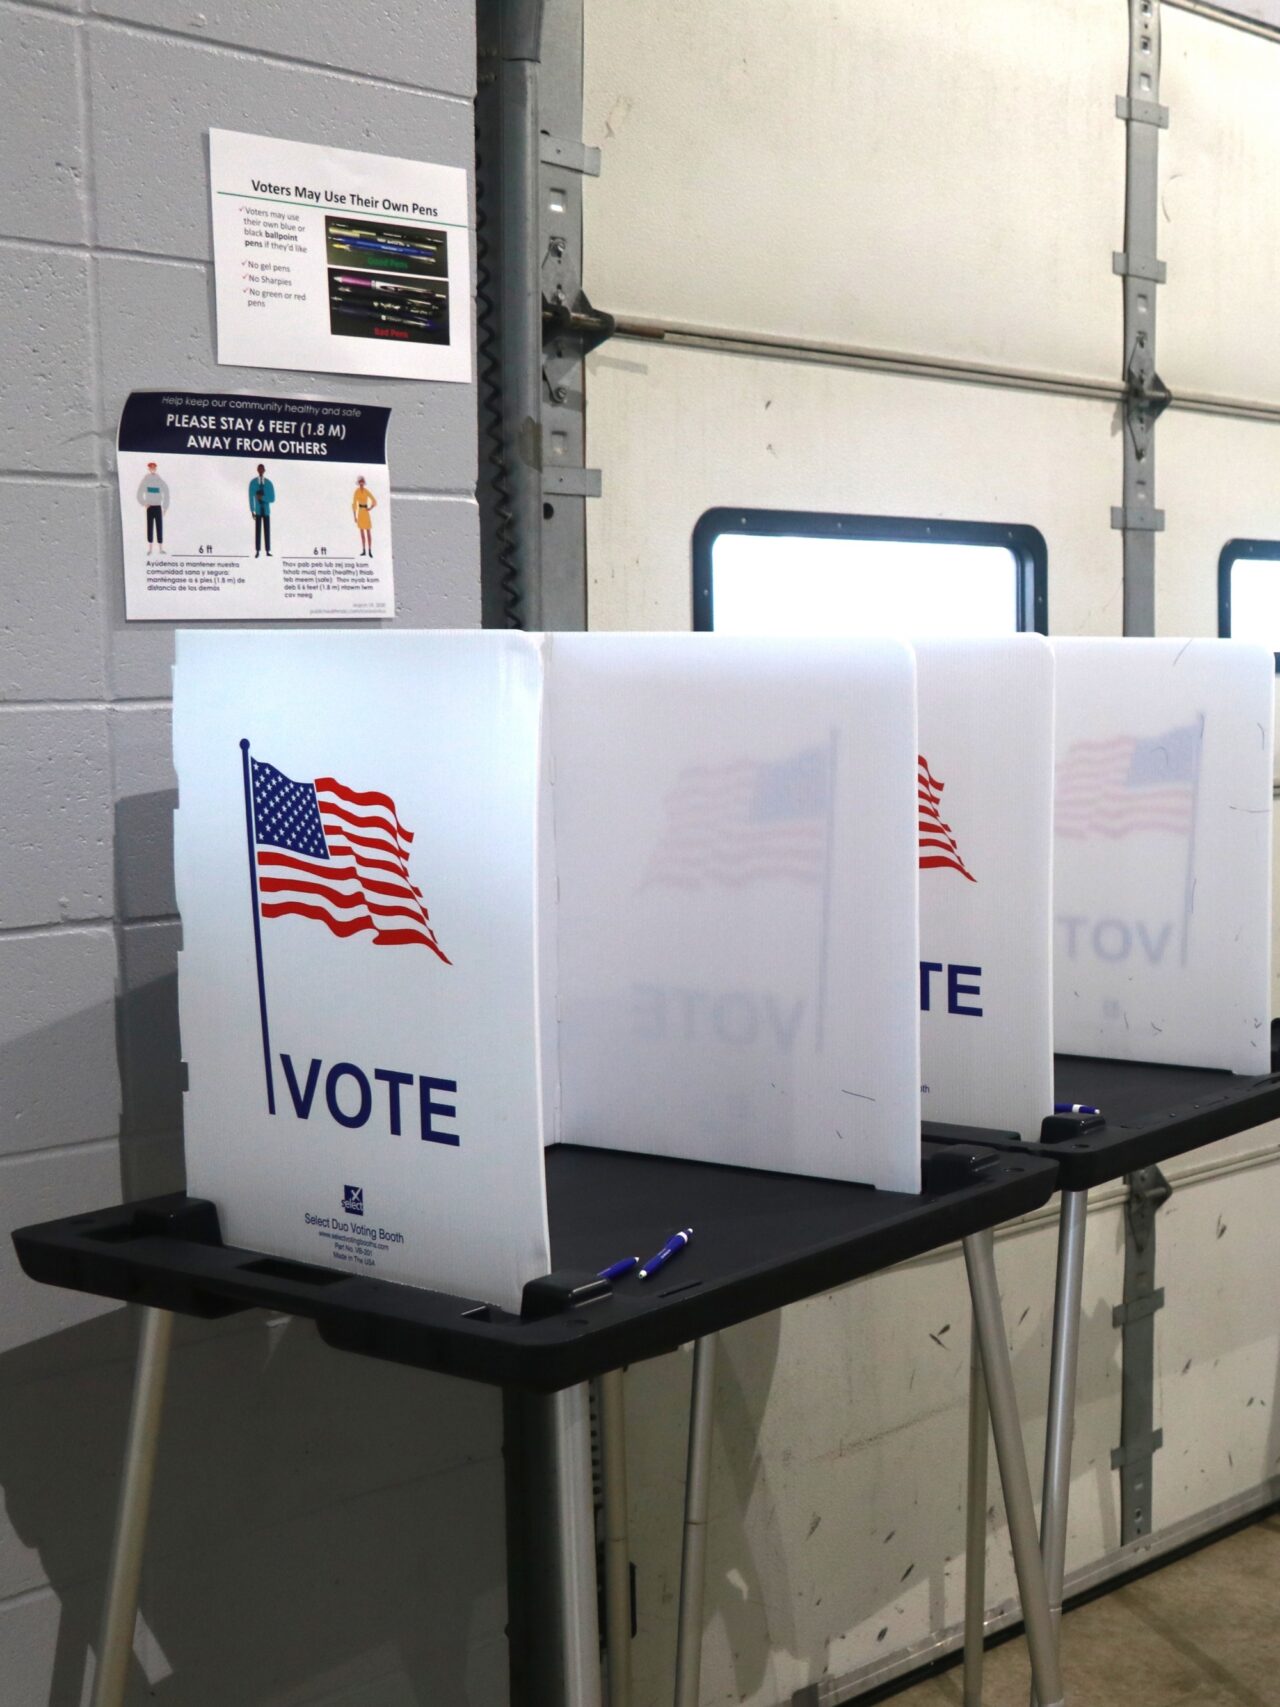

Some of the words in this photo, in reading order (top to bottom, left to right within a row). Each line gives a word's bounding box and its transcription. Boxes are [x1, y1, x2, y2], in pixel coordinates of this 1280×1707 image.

[252, 179, 292, 197] Voters
[295, 185, 321, 202] May
[325, 190, 346, 204] Use
[350, 194, 379, 209] Their
[383, 199, 408, 213] Own
[412, 203, 438, 217] Pens
[246, 207, 269, 216] Voters
[270, 212, 285, 220] may
[244, 218, 261, 226] their
[263, 221, 279, 229] own
[281, 223, 296, 231] blue
[244, 229, 263, 237] black
[265, 231, 298, 241] ballpoint
[271, 242, 293, 252] they'd
[295, 244, 308, 253] like
[248, 261, 259, 269] No
[261, 263, 271, 271] gel
[261, 276, 292, 286] Sharpies
[250, 288, 260, 296] No
[262, 290, 283, 298] green
[162, 396, 183, 405] Help
[186, 397, 209, 407] keep
[212, 399, 227, 407] our
[229, 400, 282, 413] community
[284, 403, 319, 415] healthy
[322, 407, 340, 416] and
[342, 408, 361, 417] safe
[166, 414, 216, 429] PLEASE
[221, 417, 254, 431] STAY
[258, 420, 265, 432] 6
[270, 420, 296, 434] FEET
[300, 422, 325, 438] (1.8
[328, 424, 346, 440] M)
[187, 435, 231, 449] AWAY
[237, 438, 274, 453] FROM
[279, 441, 328, 455] OTHERS
[199, 545, 204, 553] 6
[207, 546, 212, 554] ft
[314, 547, 318, 555] 6
[321, 547, 327, 555] ft
[919, 961, 984, 1017] TE
[280, 1053, 460, 1147] VOTE
[305, 1212, 330, 1229] Select
[332, 1219, 349, 1231] Duo
[350, 1222, 377, 1240] Voting
[379, 1228, 404, 1243] Booth
